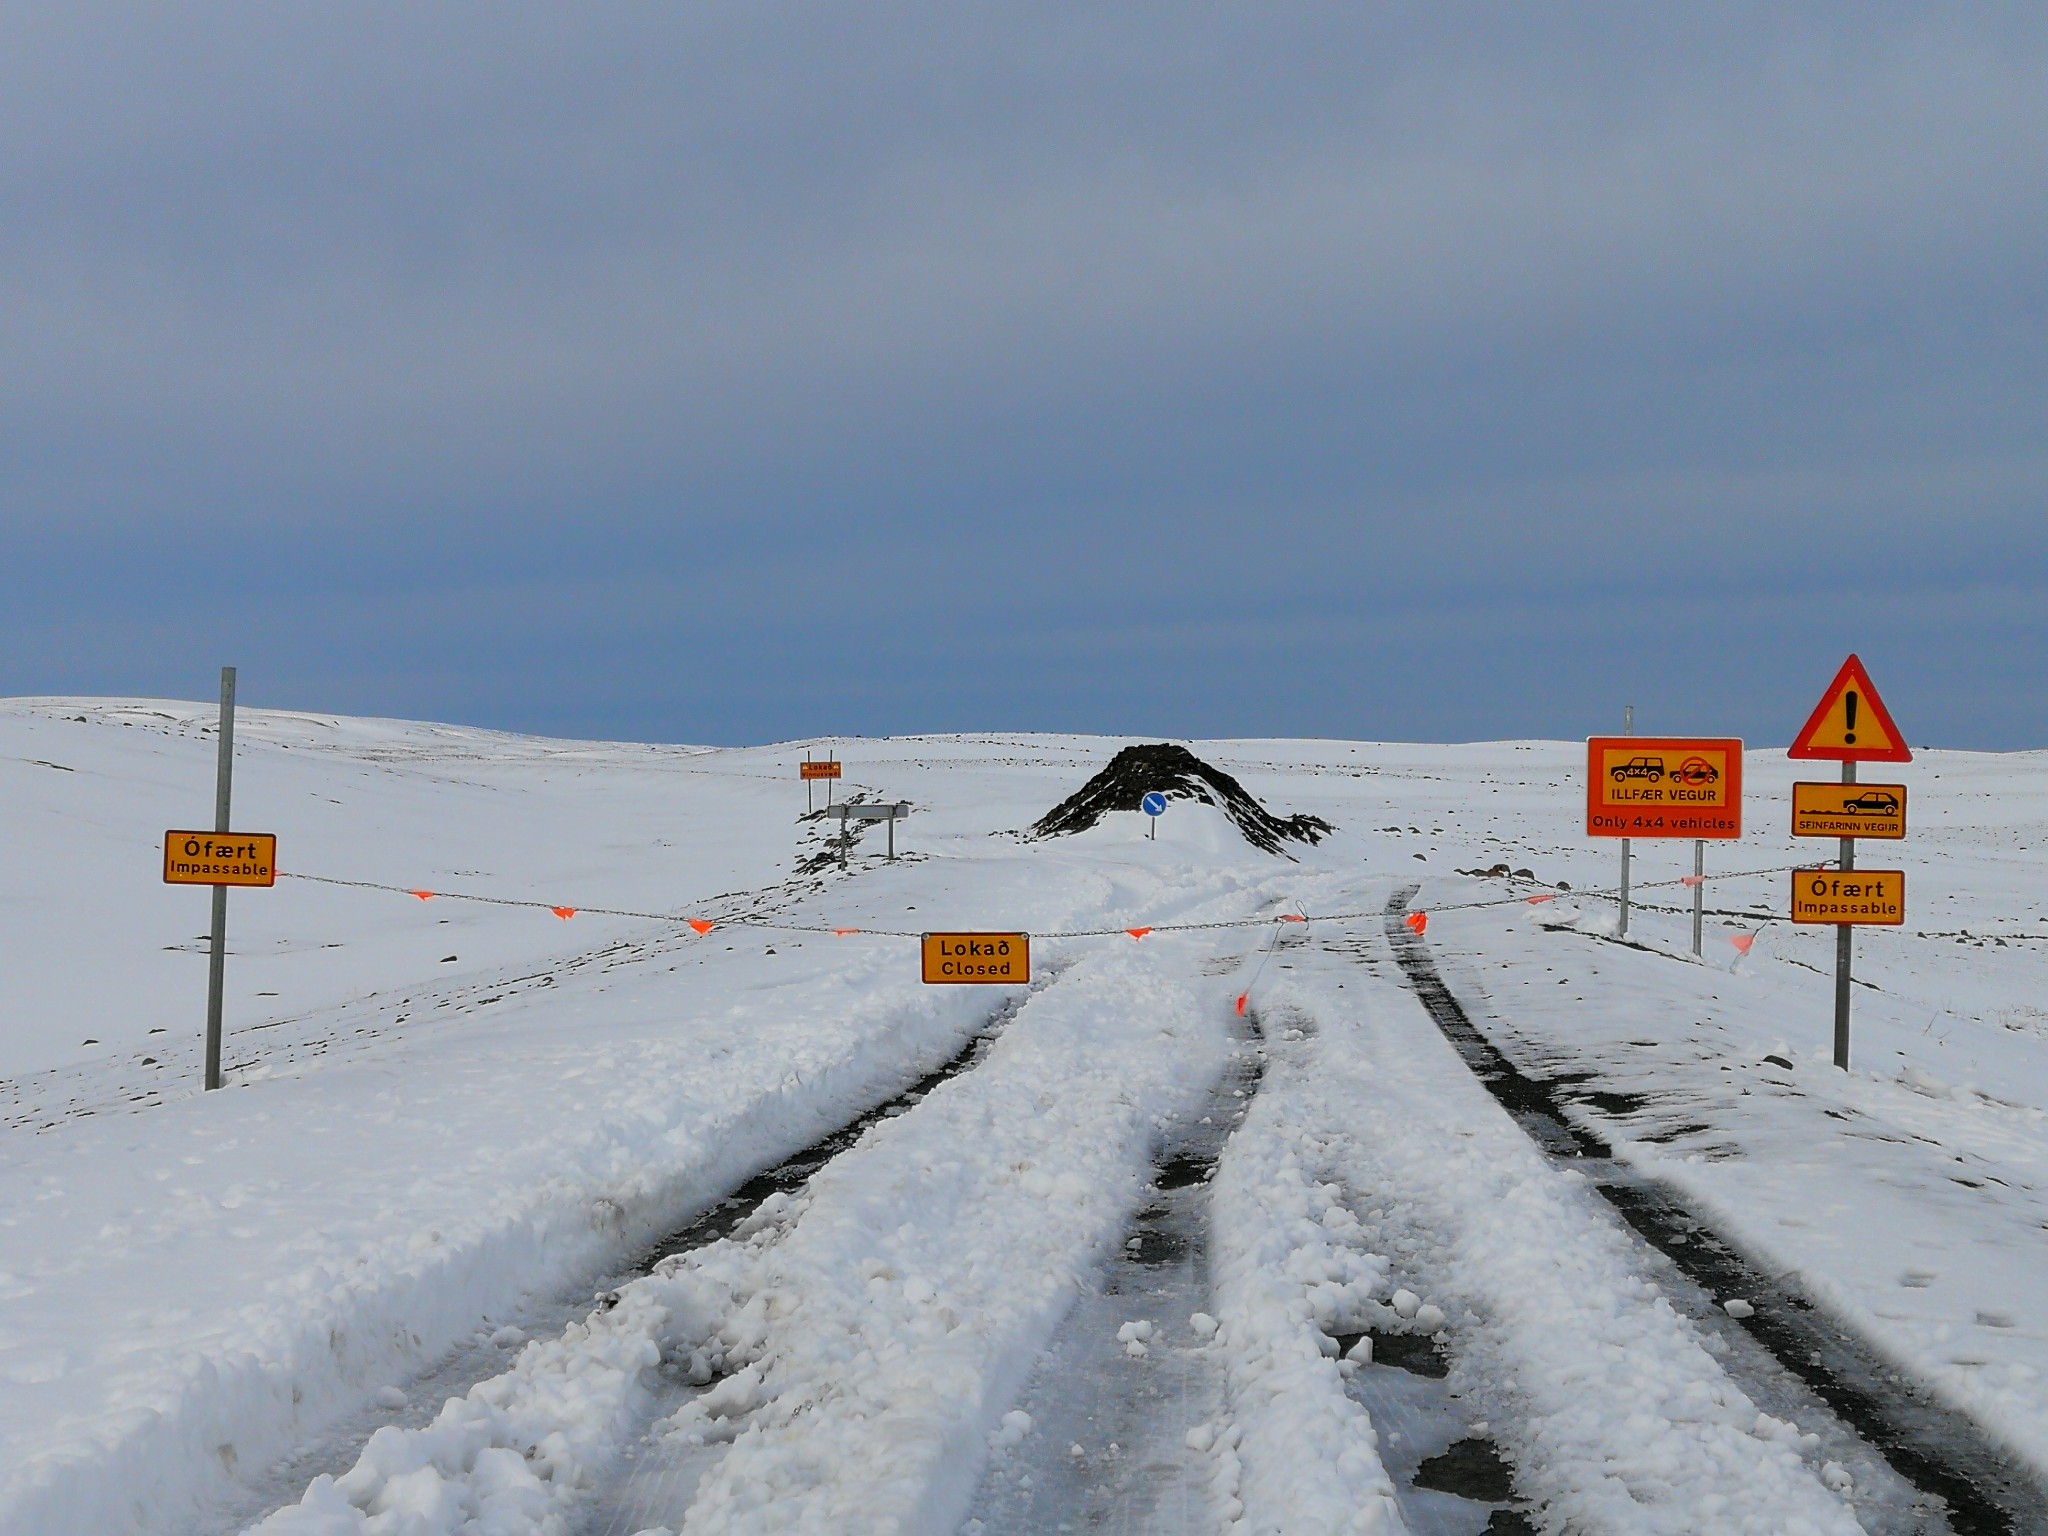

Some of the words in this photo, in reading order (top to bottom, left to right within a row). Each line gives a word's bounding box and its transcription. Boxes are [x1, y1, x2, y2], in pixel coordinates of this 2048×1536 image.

[1611, 789, 1663, 800] ILLFÆR
[1669, 790, 1716, 801] VEGUR
[1593, 816, 1627, 829] Only
[1633, 817, 1664, 828] 4x4
[1671, 817, 1735, 829] vehicles
[1800, 821, 1860, 830] SEINFARINN
[1864, 823, 1899, 832] VEGUR
[184, 836, 256, 859] Ófært
[171, 861, 268, 875] Impassable
[1811, 875, 1884, 897] Ófært
[1798, 901, 1897, 915] Impassable
[941, 940, 1010, 956] Lokað
[942, 962, 1010, 975] Closed
